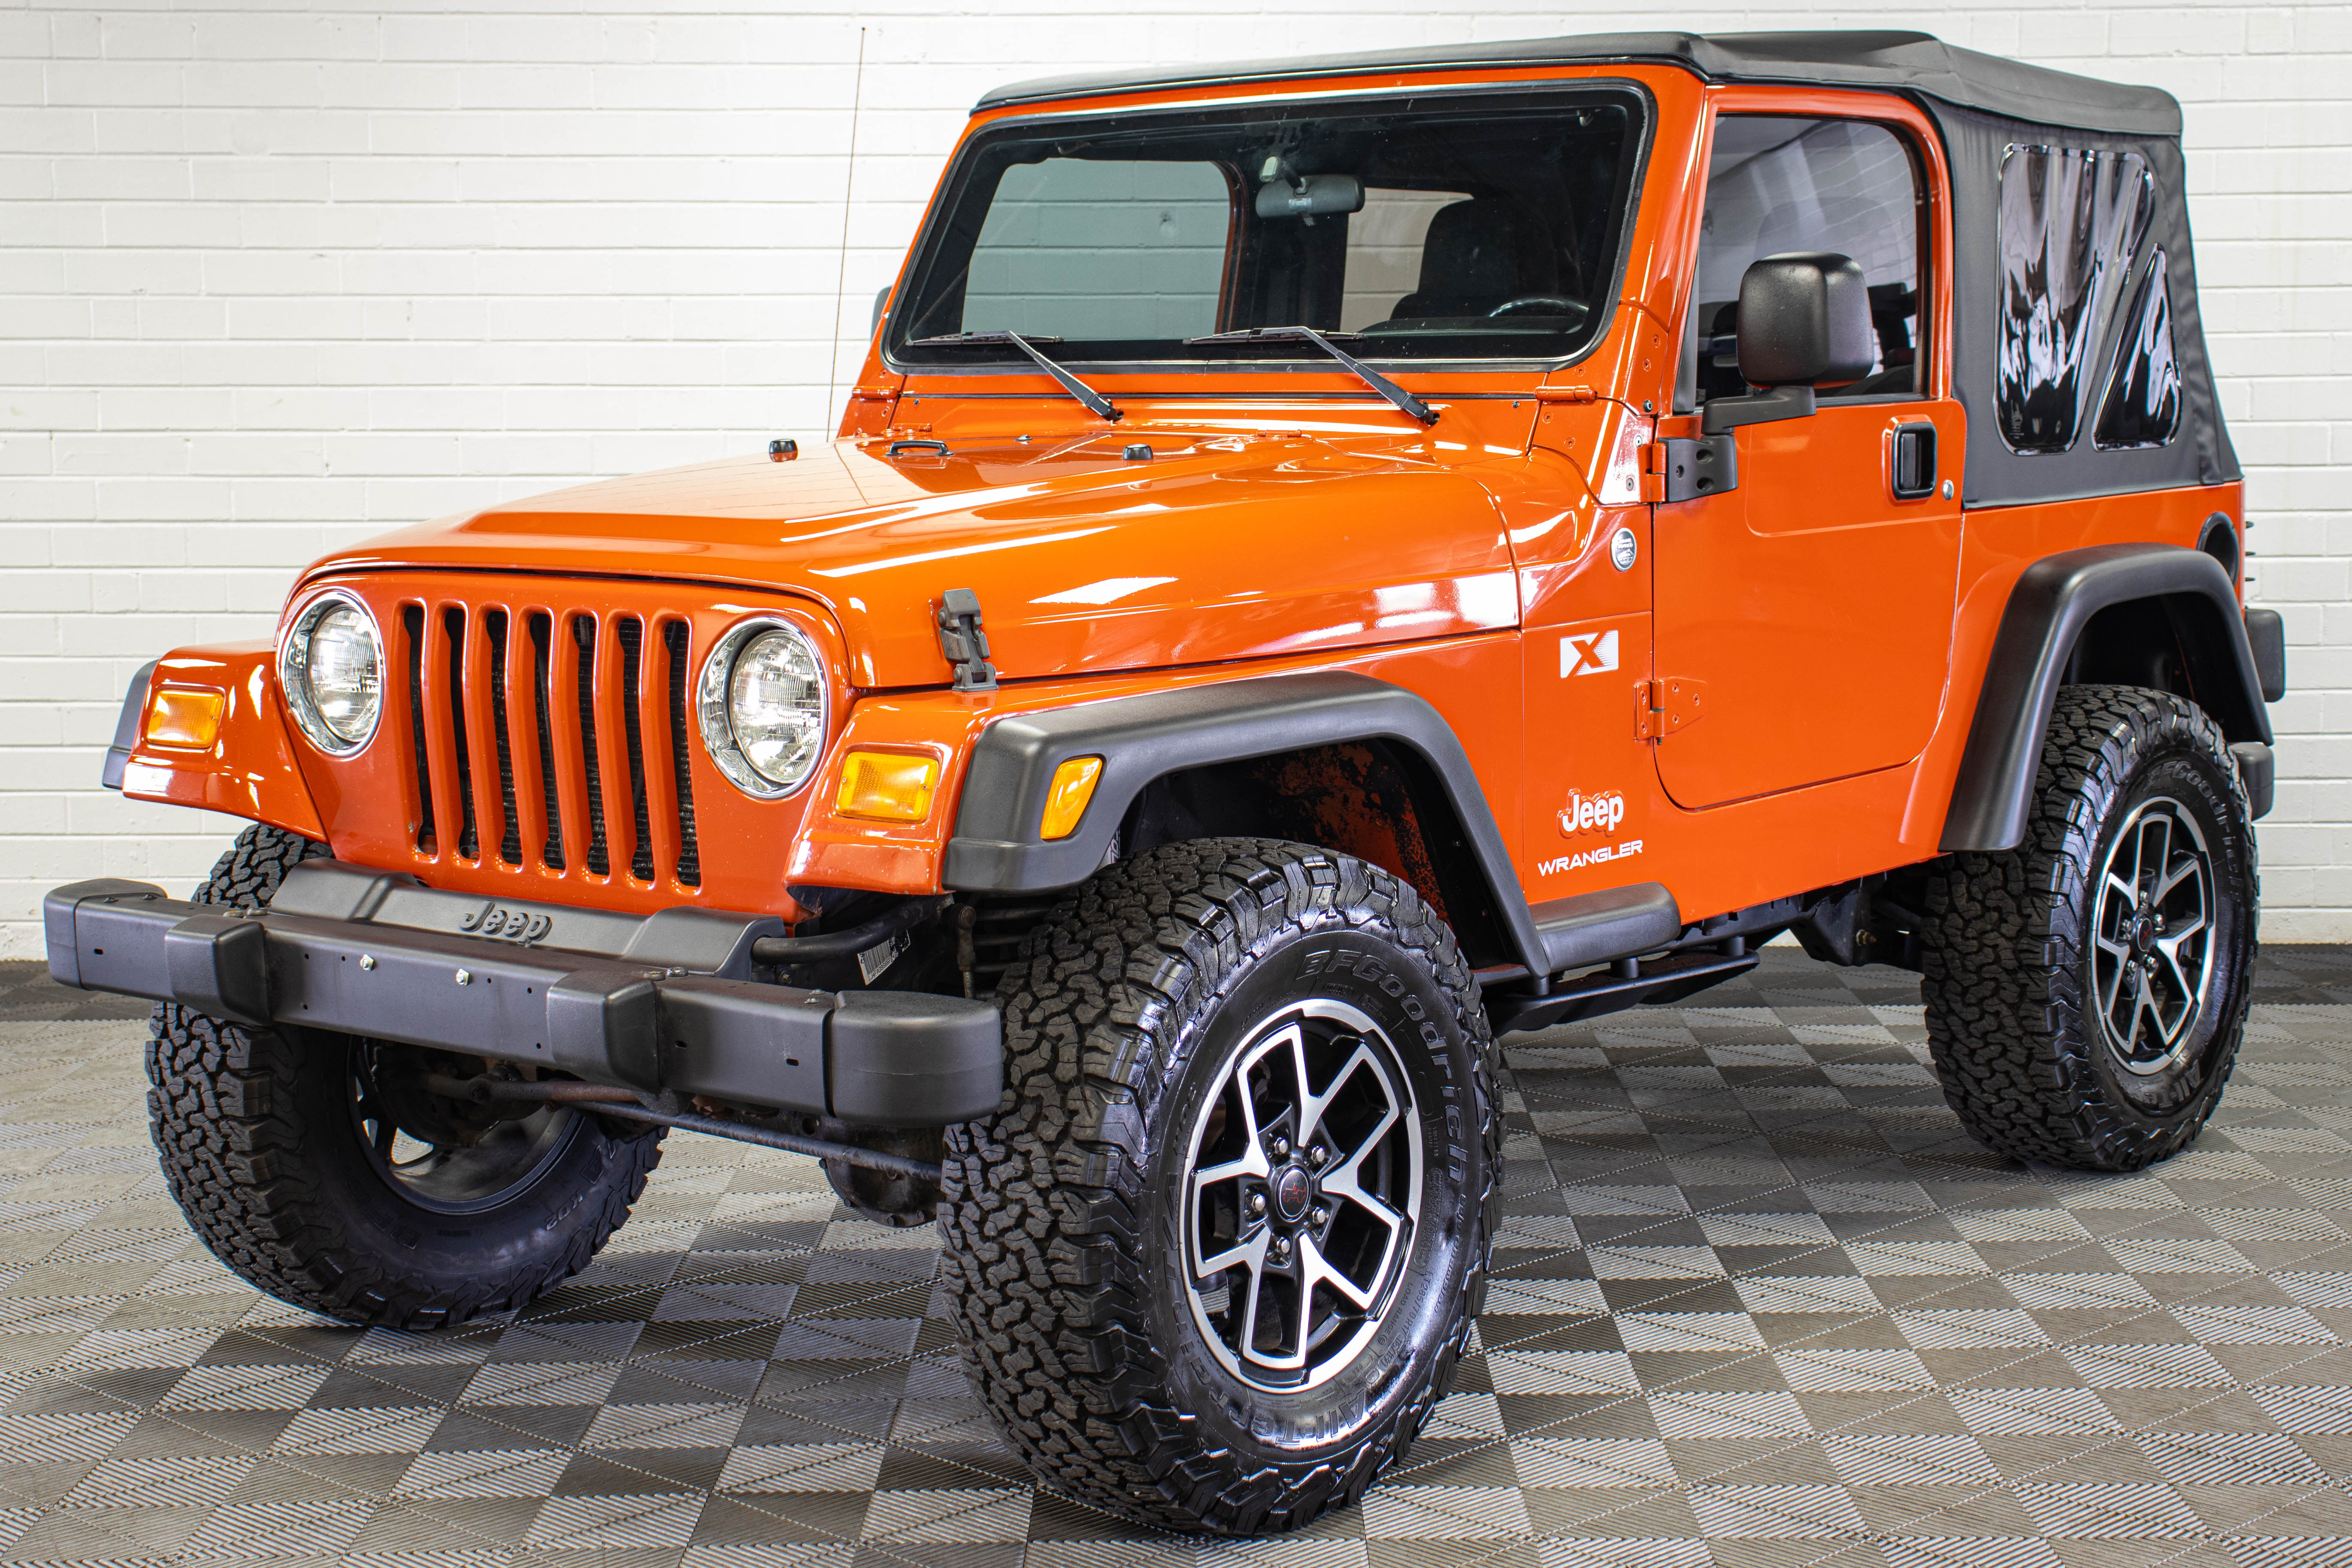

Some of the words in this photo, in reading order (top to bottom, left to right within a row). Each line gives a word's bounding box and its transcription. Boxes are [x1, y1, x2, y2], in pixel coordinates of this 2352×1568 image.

[1565, 630, 1608, 678] X
[1562, 794, 1623, 832] Jeep
[1538, 839, 1643, 876] WRANGLER
[460, 900, 553, 947] Jeep
[1295, 948, 1470, 1183] BFGoodrich
[545, 1190, 583, 1231] KO2
[1399, 1281, 1414, 1307] LOAD
[1384, 1306, 1403, 1335] RANGE
[1166, 1297, 1377, 1447] All-Terrain
